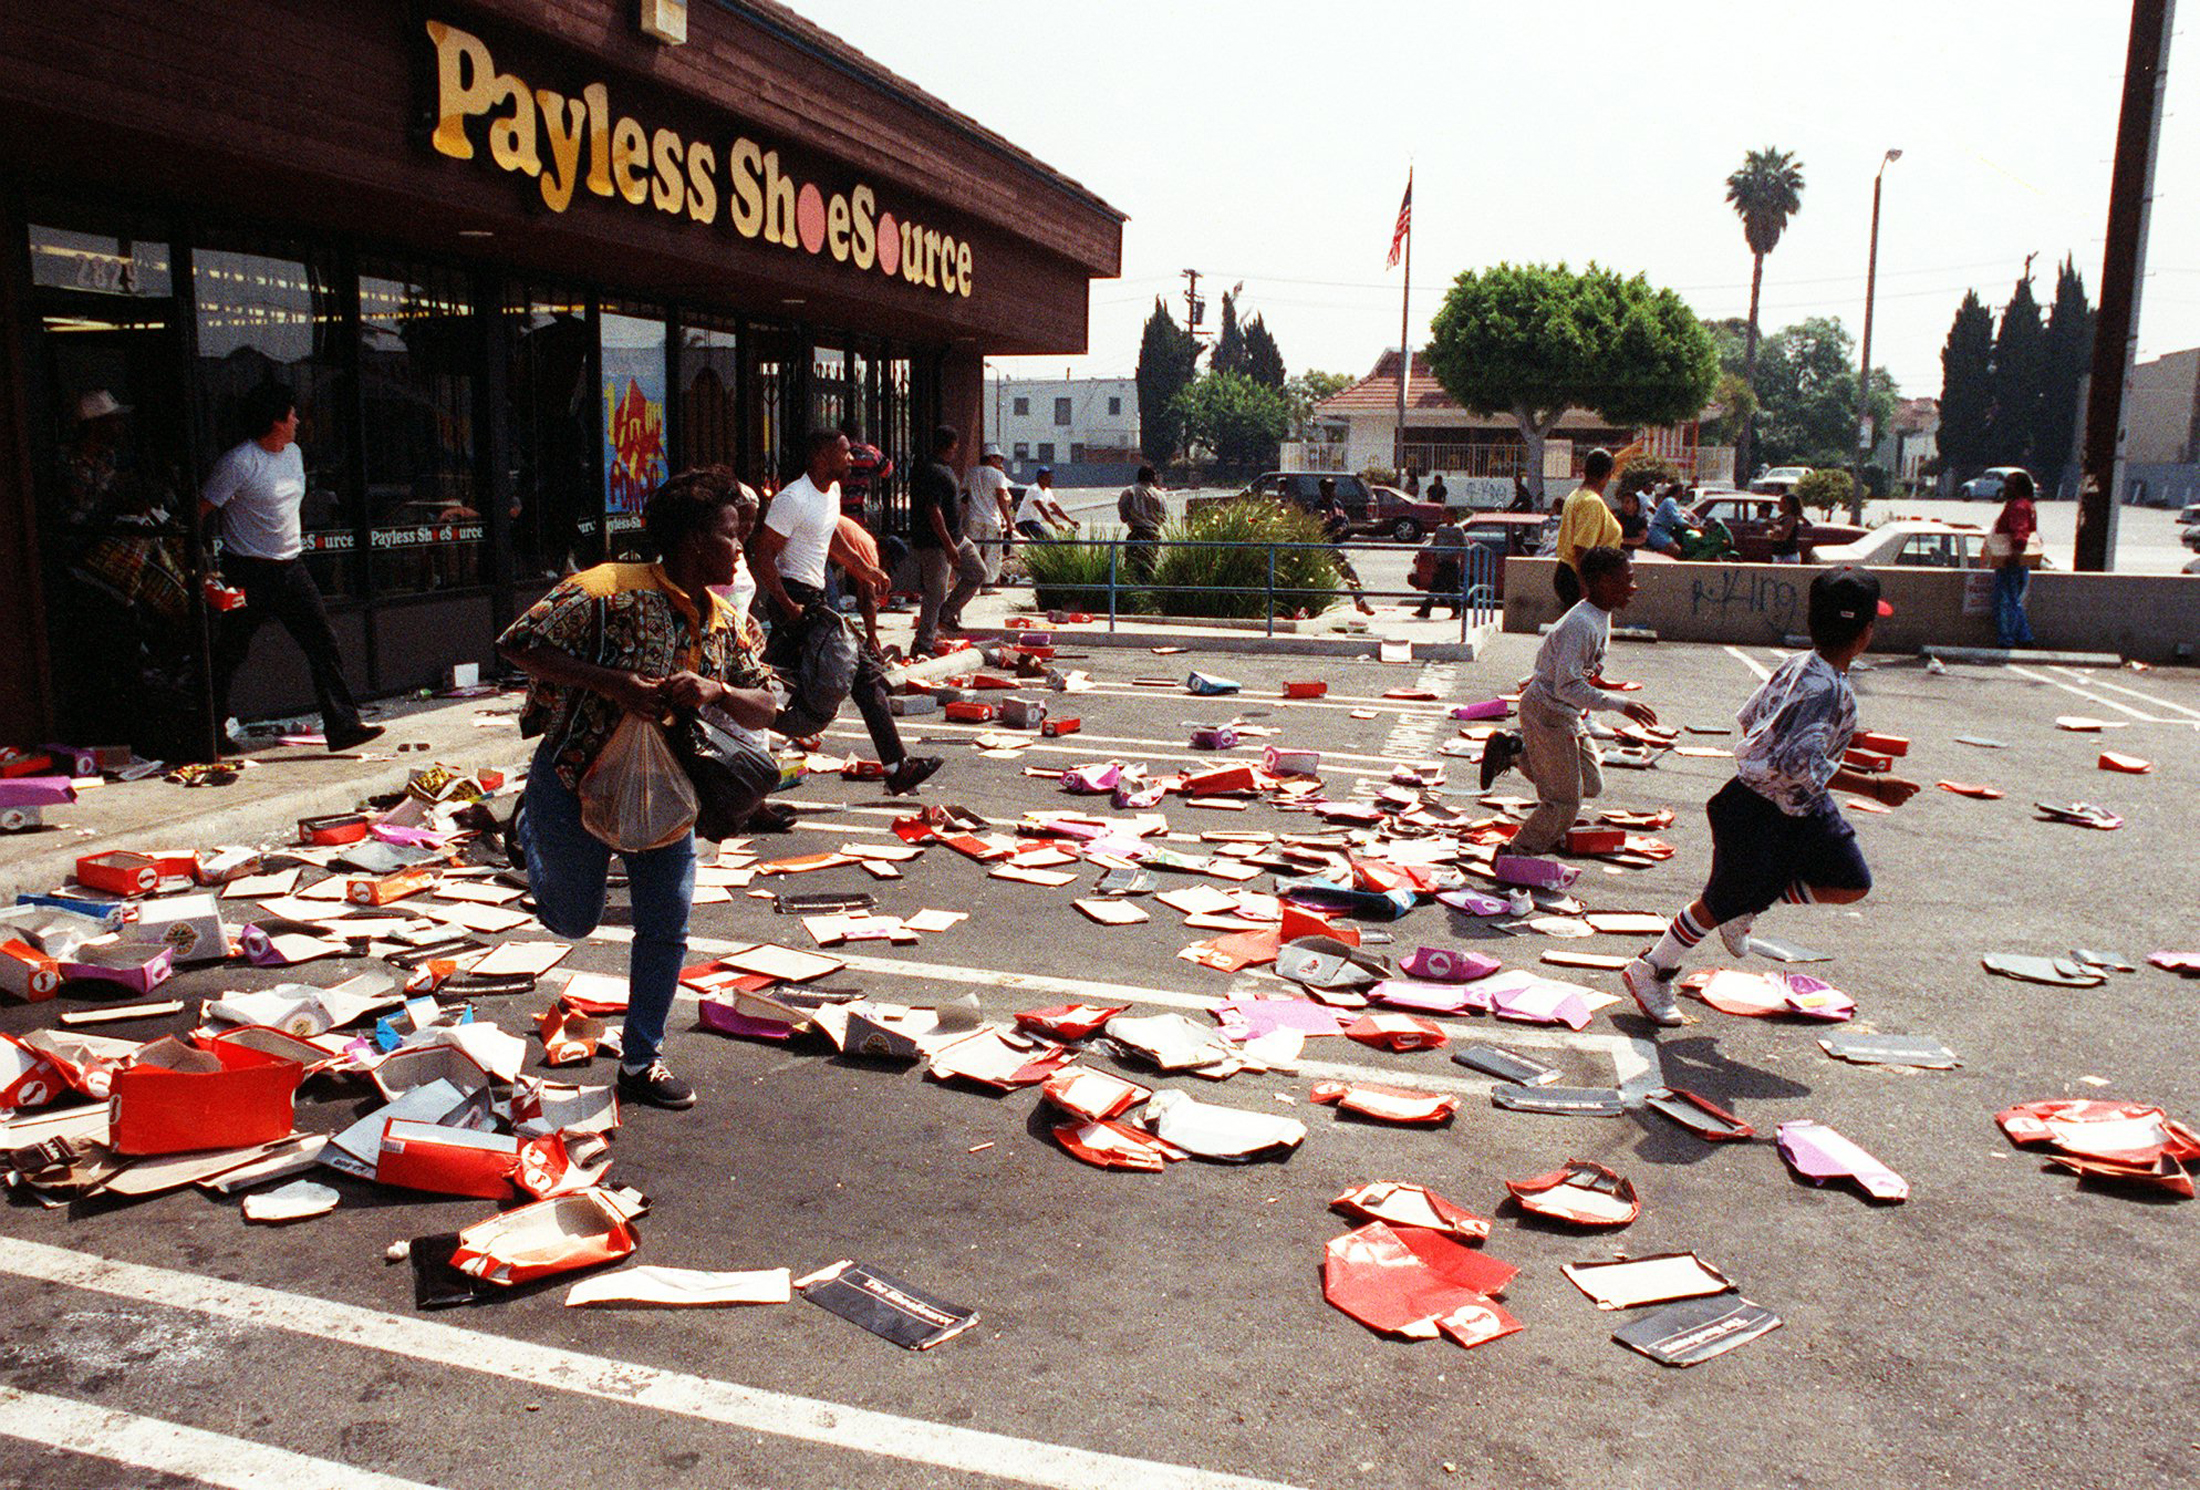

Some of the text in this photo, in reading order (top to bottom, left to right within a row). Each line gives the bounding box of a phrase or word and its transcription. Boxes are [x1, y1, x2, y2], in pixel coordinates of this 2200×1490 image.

[426, 20, 972, 298] Payless ShoeSource
[300, 533, 355, 551] eSource
[371, 525, 484, 548] Payless ShoeSource
